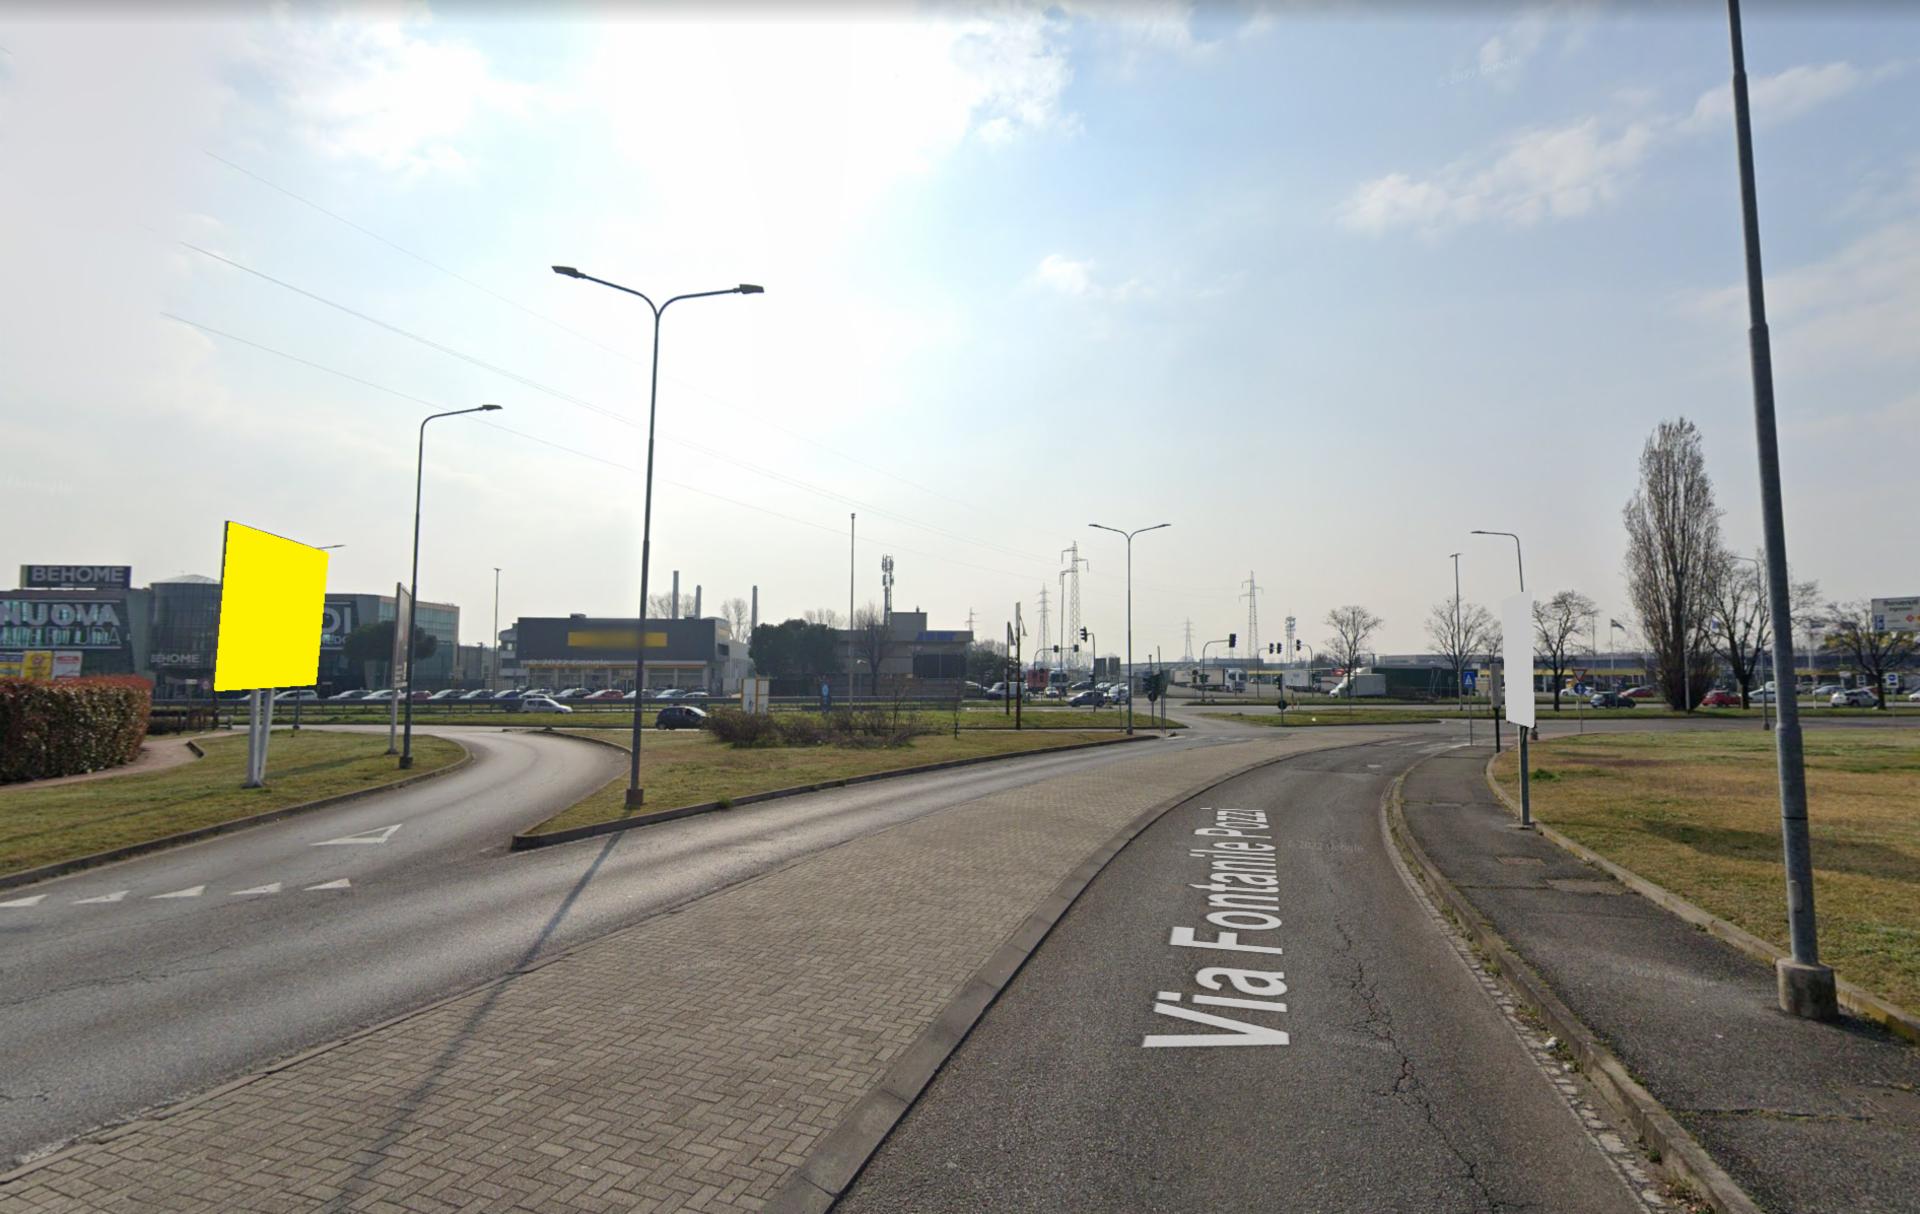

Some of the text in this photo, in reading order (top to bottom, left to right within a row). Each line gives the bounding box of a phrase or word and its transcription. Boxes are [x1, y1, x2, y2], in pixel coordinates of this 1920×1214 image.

[31, 566, 125, 583] BEHOME
[0, 602, 121, 626] NUOVA
[0, 626, 122, 645] ERTURA
